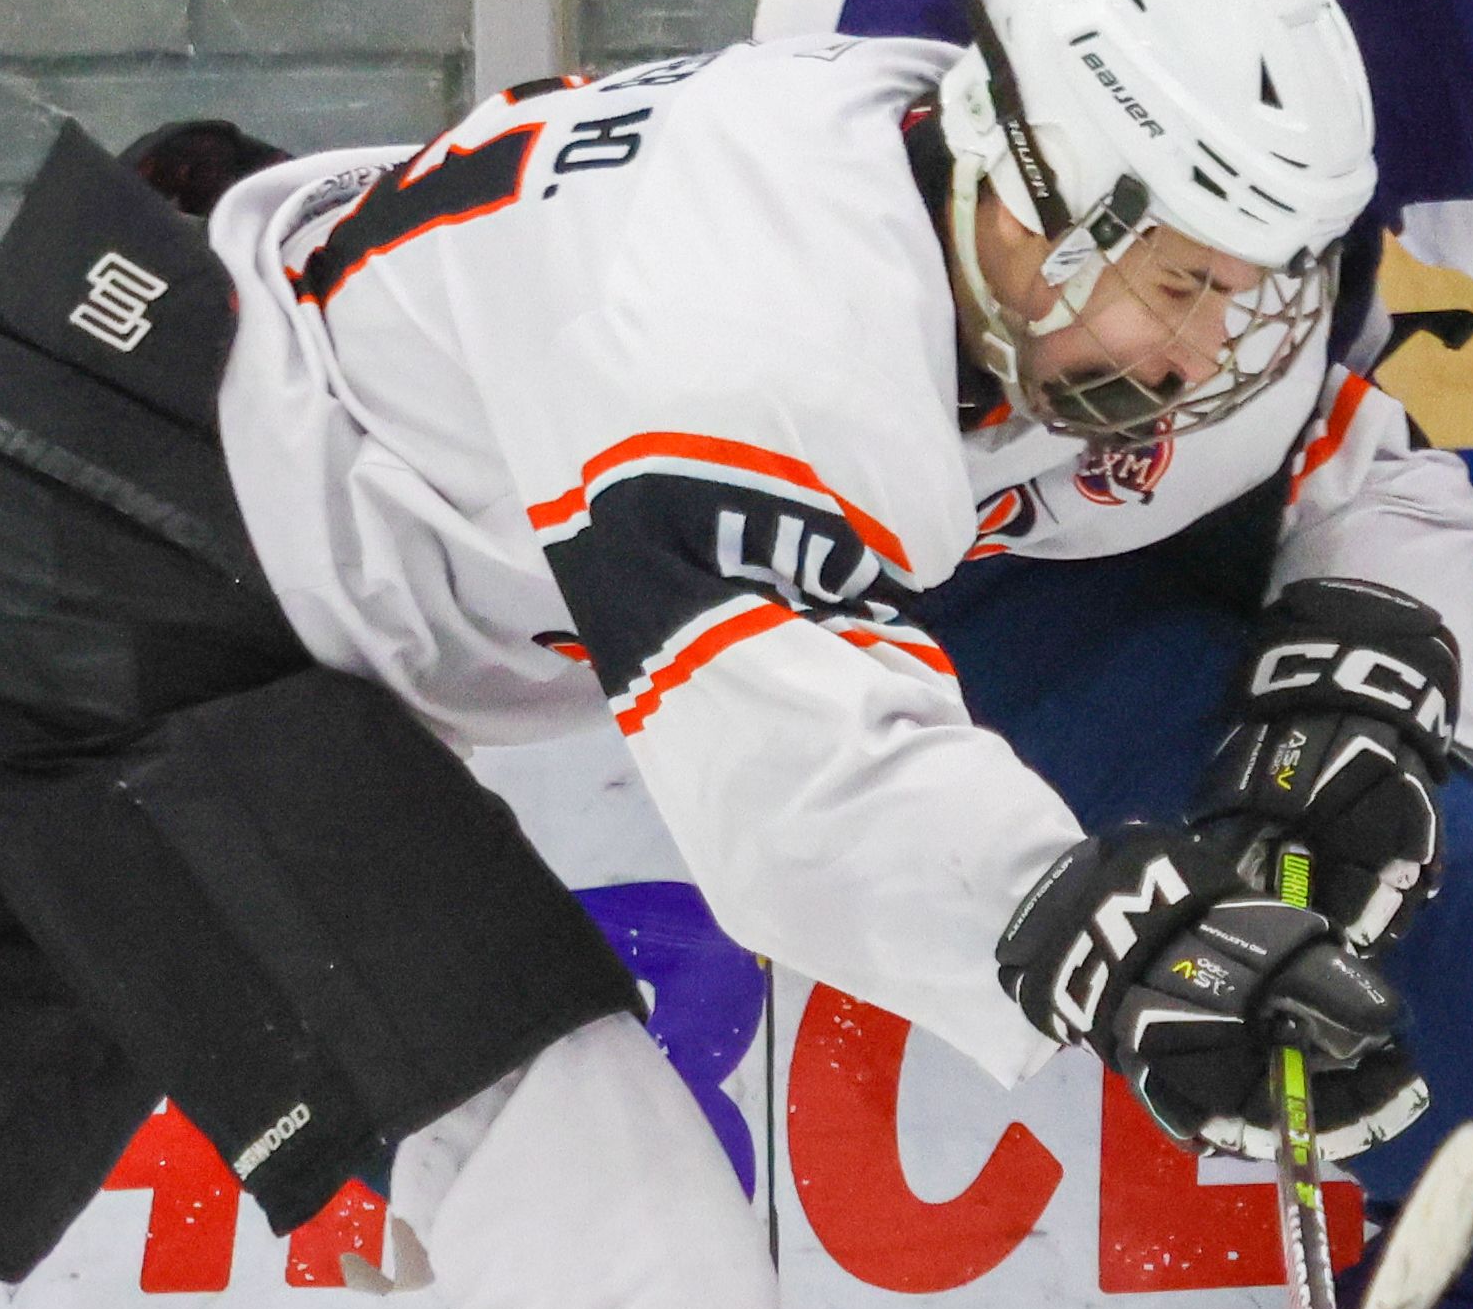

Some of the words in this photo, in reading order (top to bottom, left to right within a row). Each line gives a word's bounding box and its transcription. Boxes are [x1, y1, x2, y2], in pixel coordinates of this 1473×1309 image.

[1251, 642, 1458, 754] CCM
[1281, 854, 1310, 909] WARR
[1053, 855, 1192, 1045] CM
